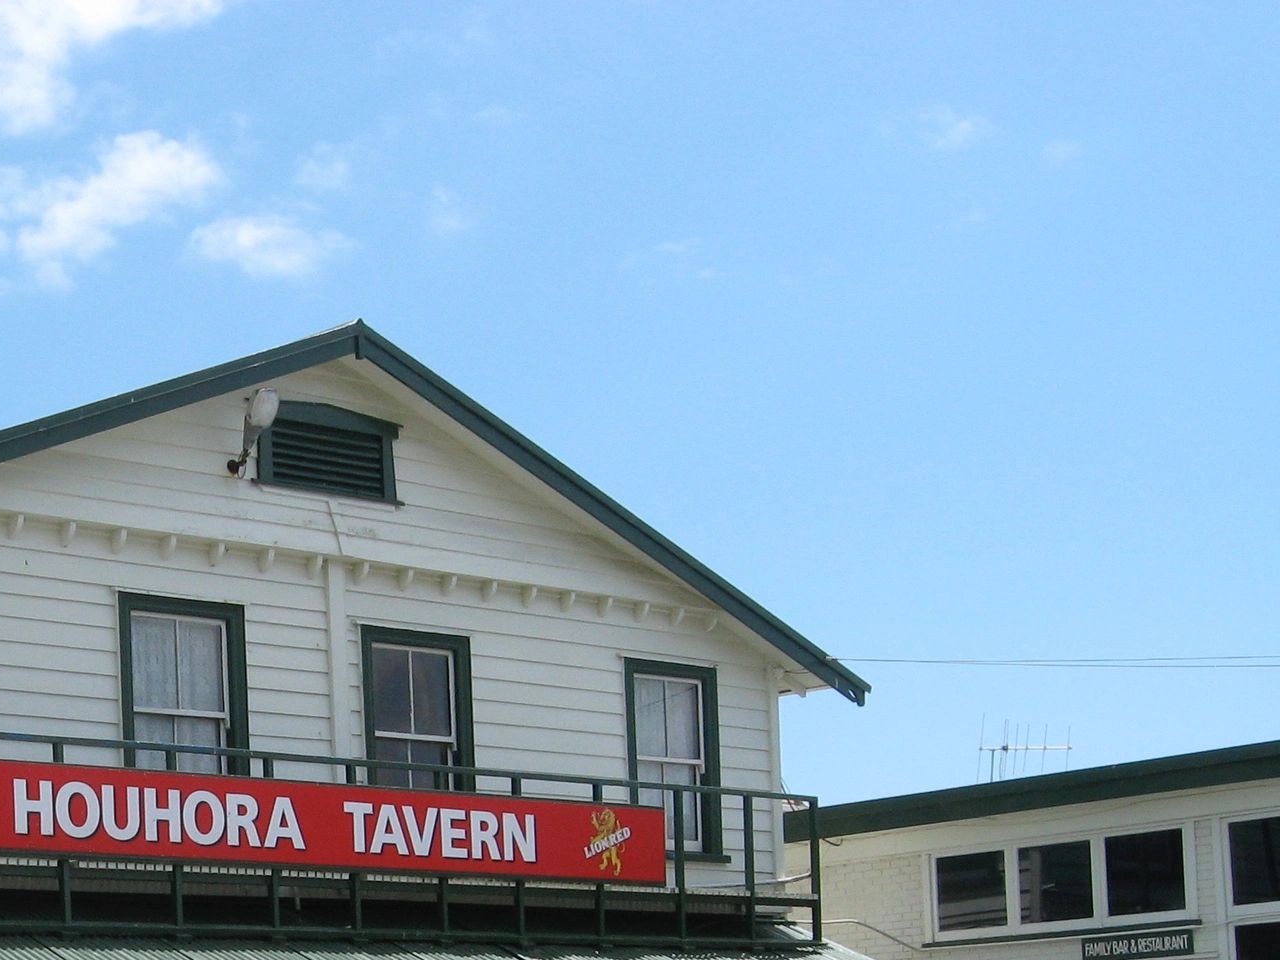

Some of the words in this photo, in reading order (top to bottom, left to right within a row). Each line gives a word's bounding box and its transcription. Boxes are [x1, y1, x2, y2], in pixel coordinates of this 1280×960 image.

[13, 778, 306, 850] HOUHORA
[343, 801, 537, 863] TAVERN
[583, 837, 609, 859] LION
[609, 826, 631, 846] RED
[1084, 941, 1112, 957] FAMILY
[1112, 939, 1129, 955] BAR
[1130, 938, 1137, 953] &
[1138, 934, 1189, 953] RESTAURANT
